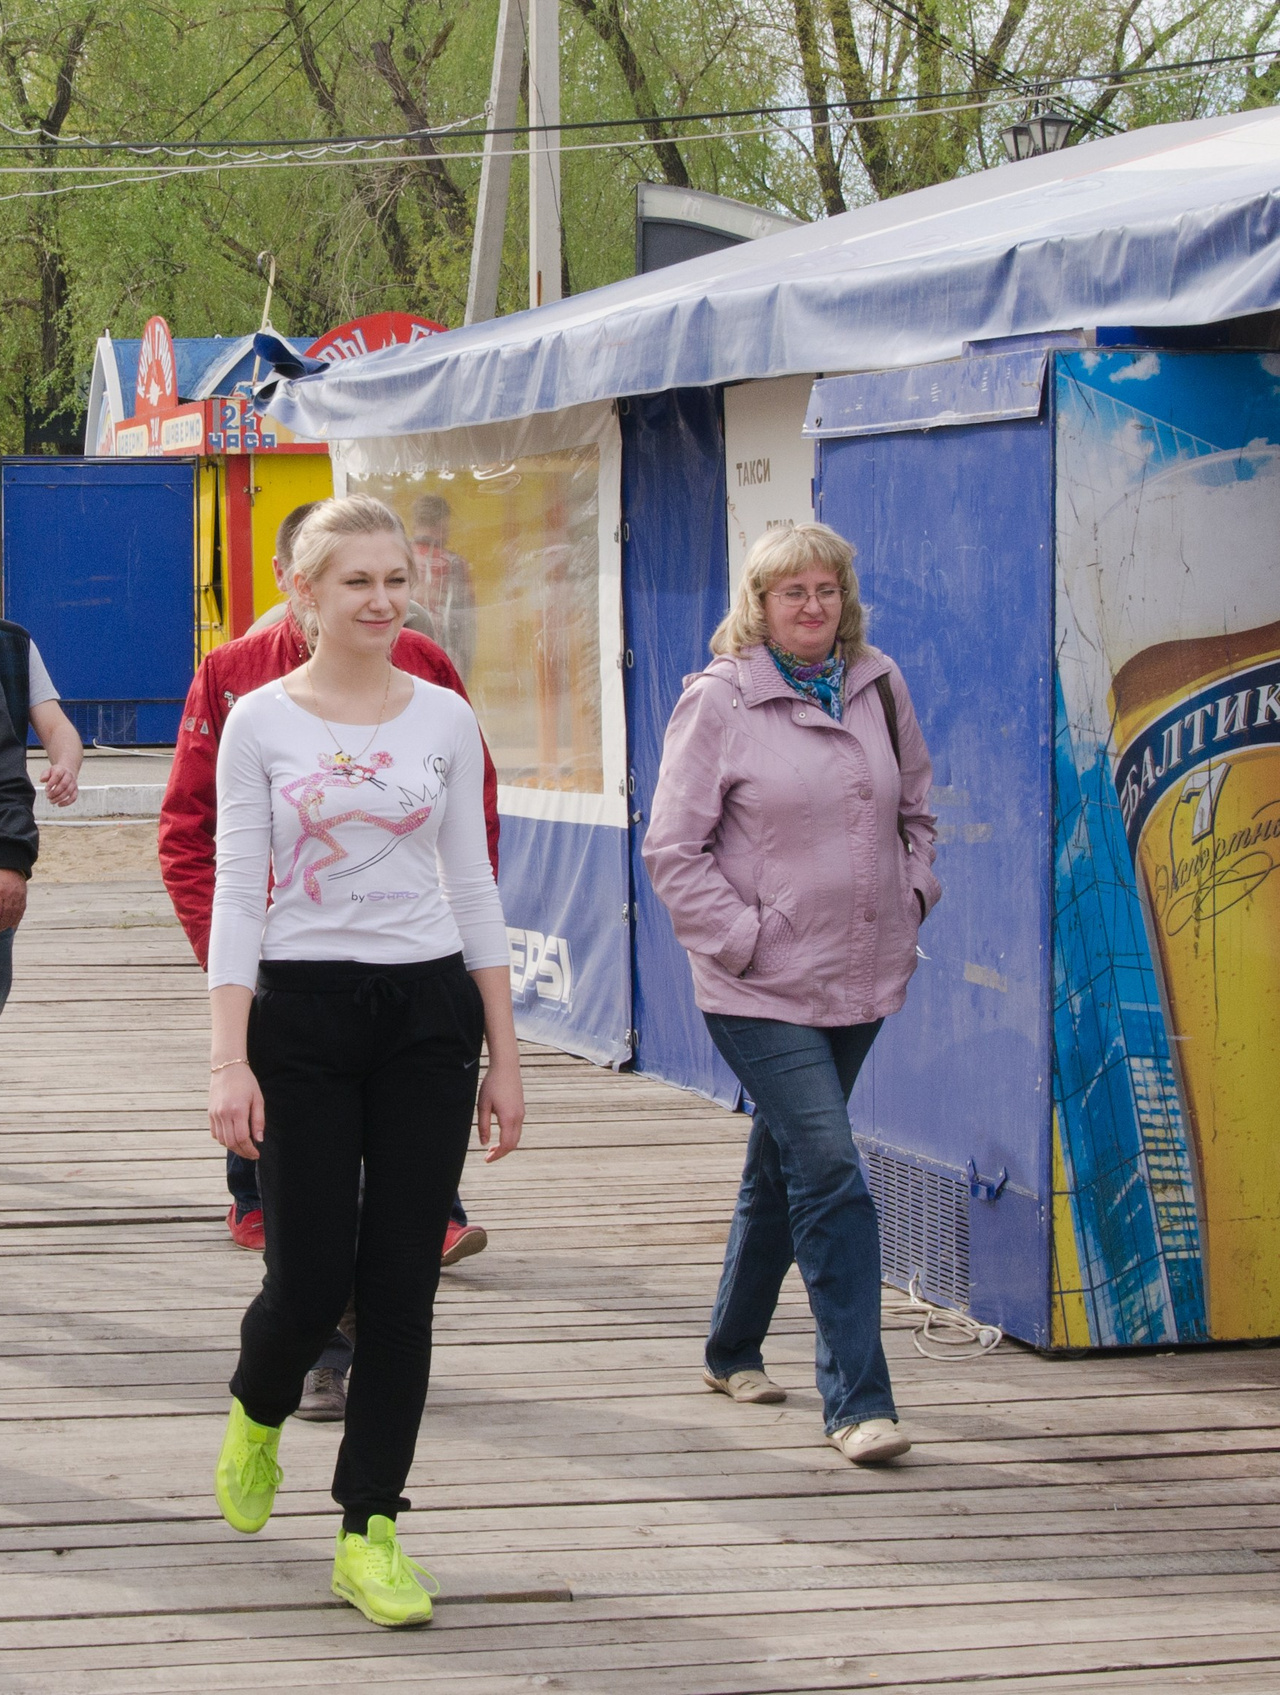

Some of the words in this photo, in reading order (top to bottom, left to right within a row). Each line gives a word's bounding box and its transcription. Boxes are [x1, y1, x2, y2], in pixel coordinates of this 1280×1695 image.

[222, 405, 257, 430] 24
[209, 432, 277, 449] ЧАСА
[736, 458, 771, 486] ТАКСИ
[1179, 761, 1232, 846] 7
[351, 891, 365, 903] by
[505, 926, 573, 1004] EPSI
